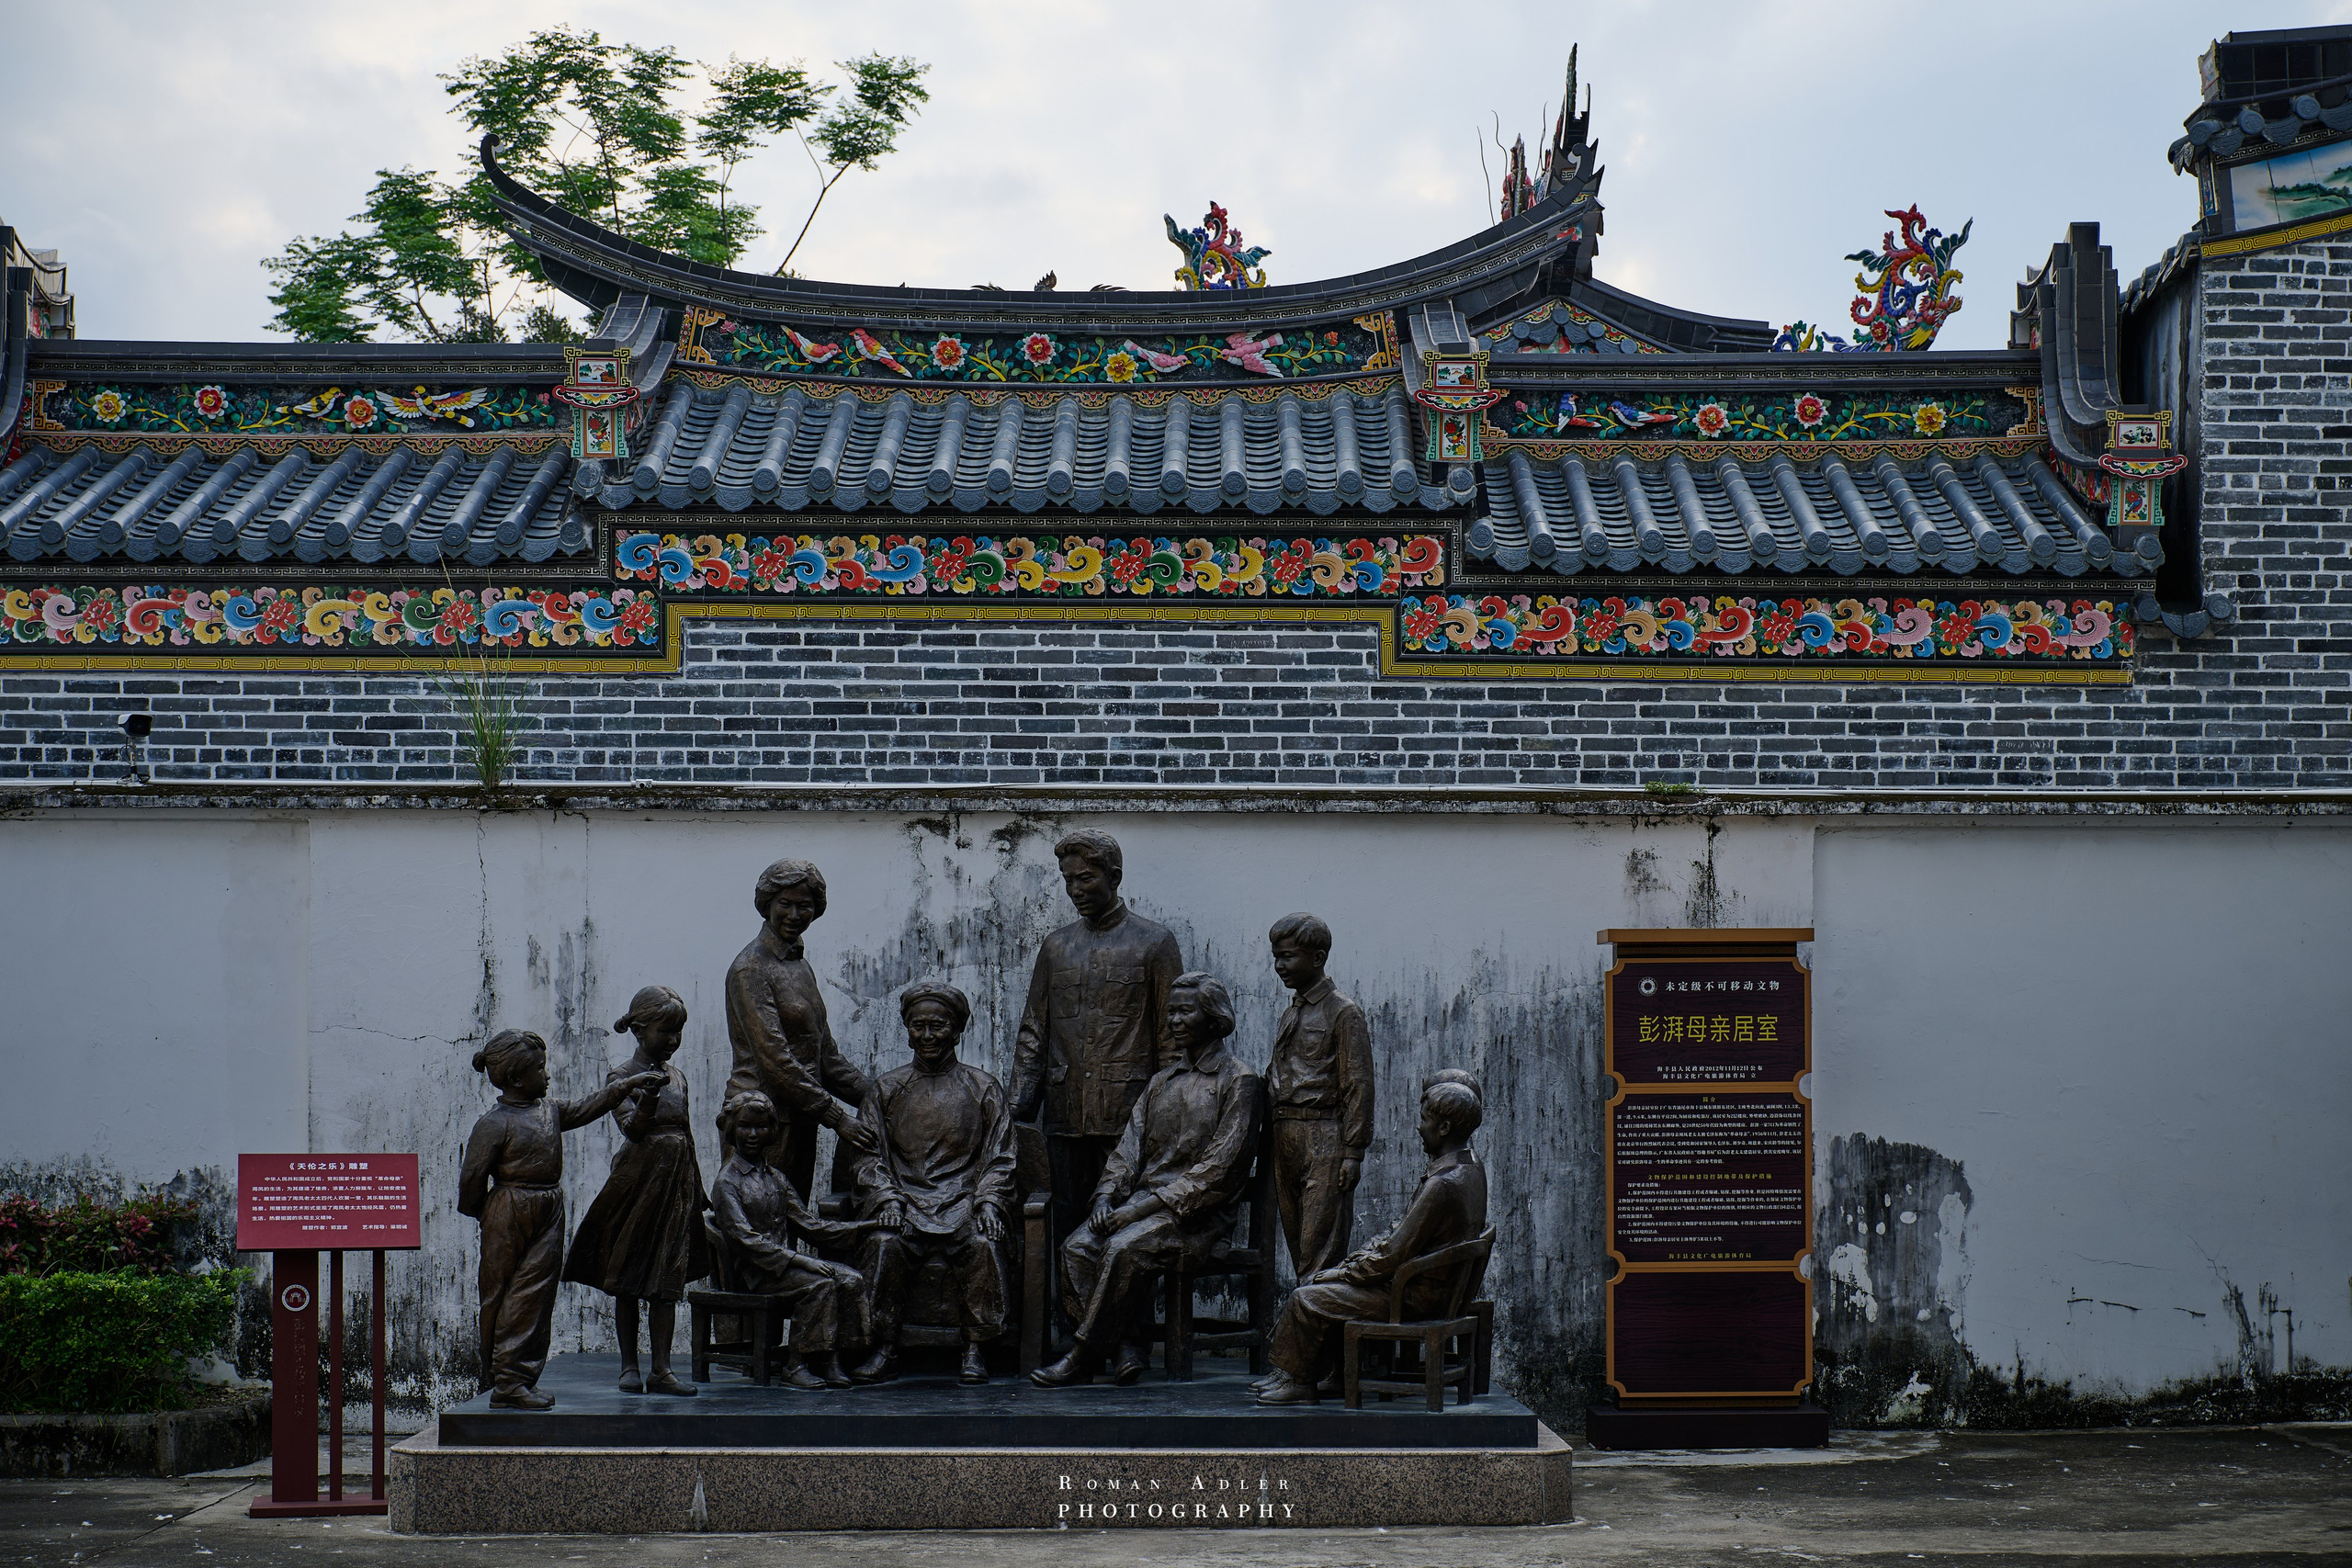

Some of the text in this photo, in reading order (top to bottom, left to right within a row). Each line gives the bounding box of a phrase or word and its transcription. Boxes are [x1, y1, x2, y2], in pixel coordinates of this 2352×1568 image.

[1666, 981, 1779, 991] 未定级不可移动文物
[1639, 1014, 1778, 1043] 彭湃母亲居室
